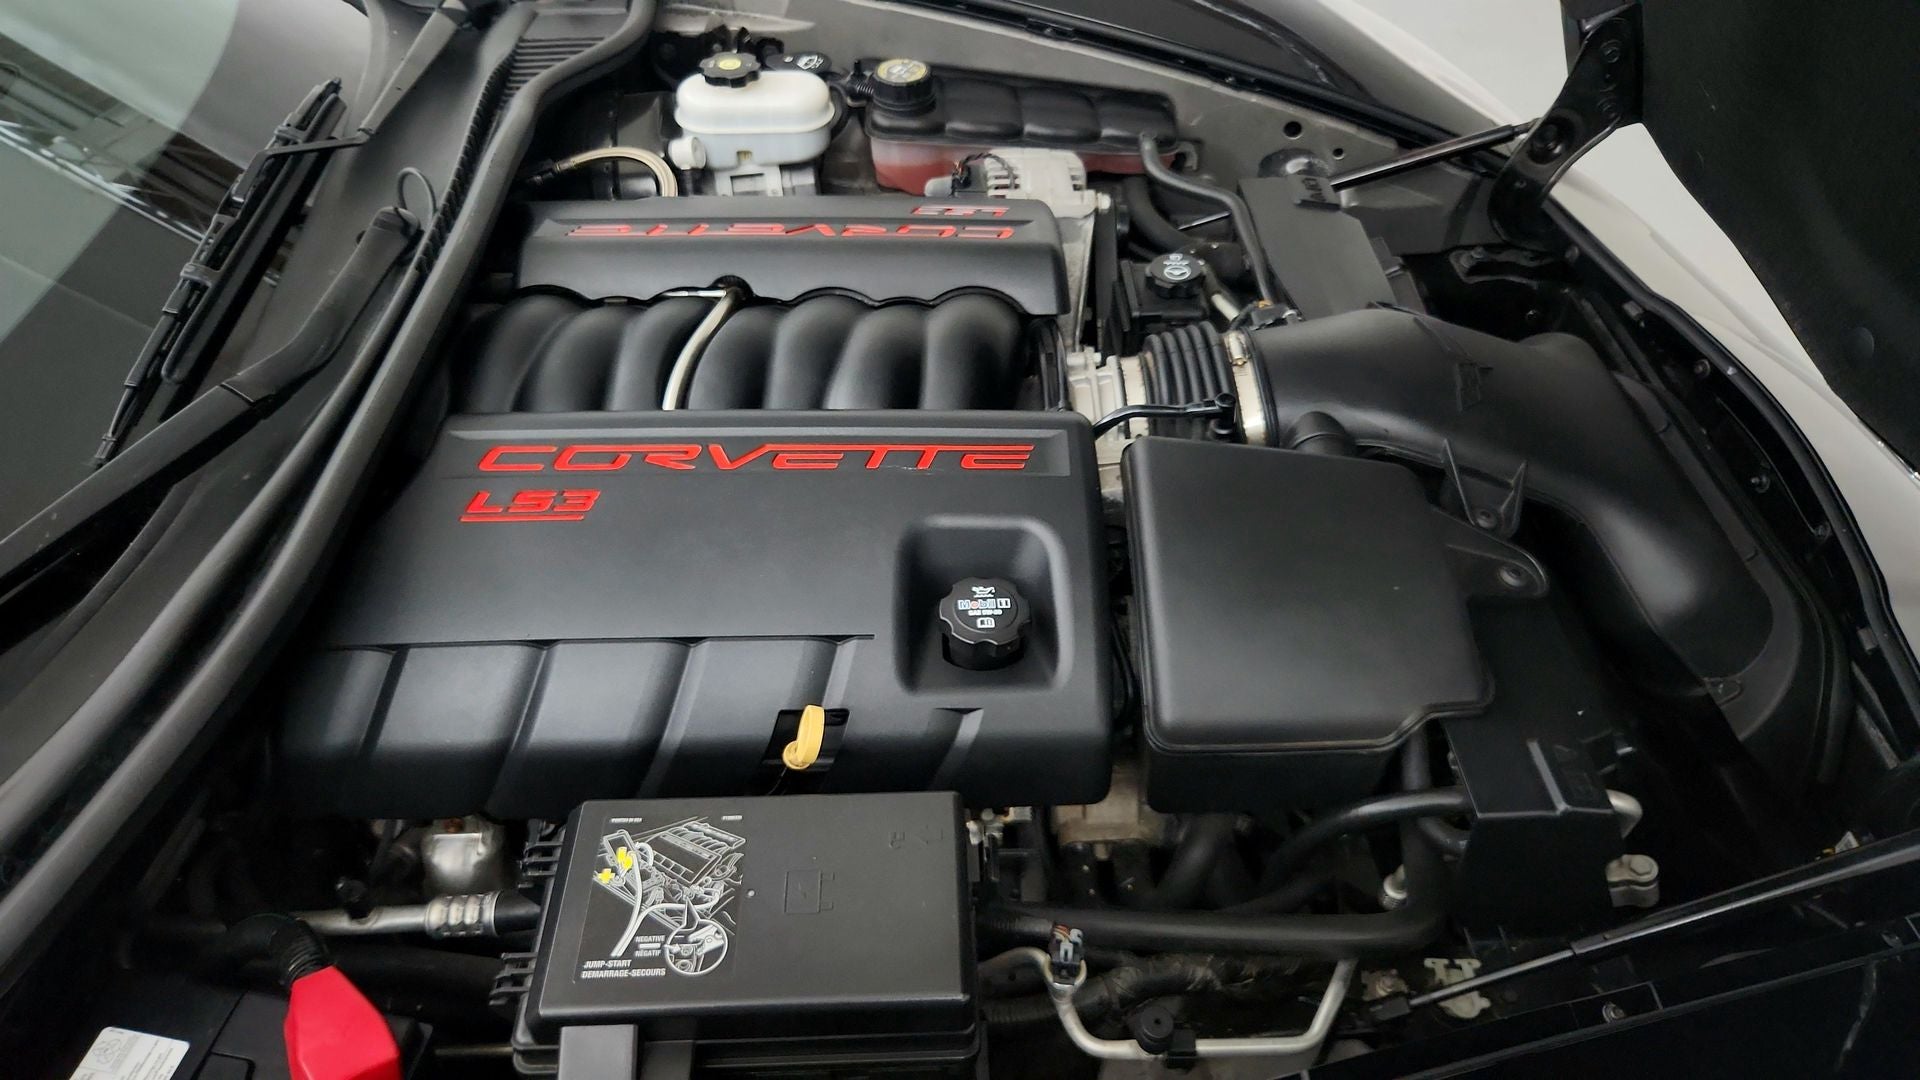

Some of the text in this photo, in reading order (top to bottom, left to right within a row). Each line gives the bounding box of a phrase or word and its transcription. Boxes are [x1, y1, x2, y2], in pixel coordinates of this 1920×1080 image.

[565, 224, 1014, 237] CORVETTE
[478, 444, 1035, 472] CORVETTE
[468, 490, 600, 514] LS3
[958, 599, 996, 610] Mobil
[635, 935, 665, 943] NEGATIVE
[583, 960, 632, 968] JUMP-START
